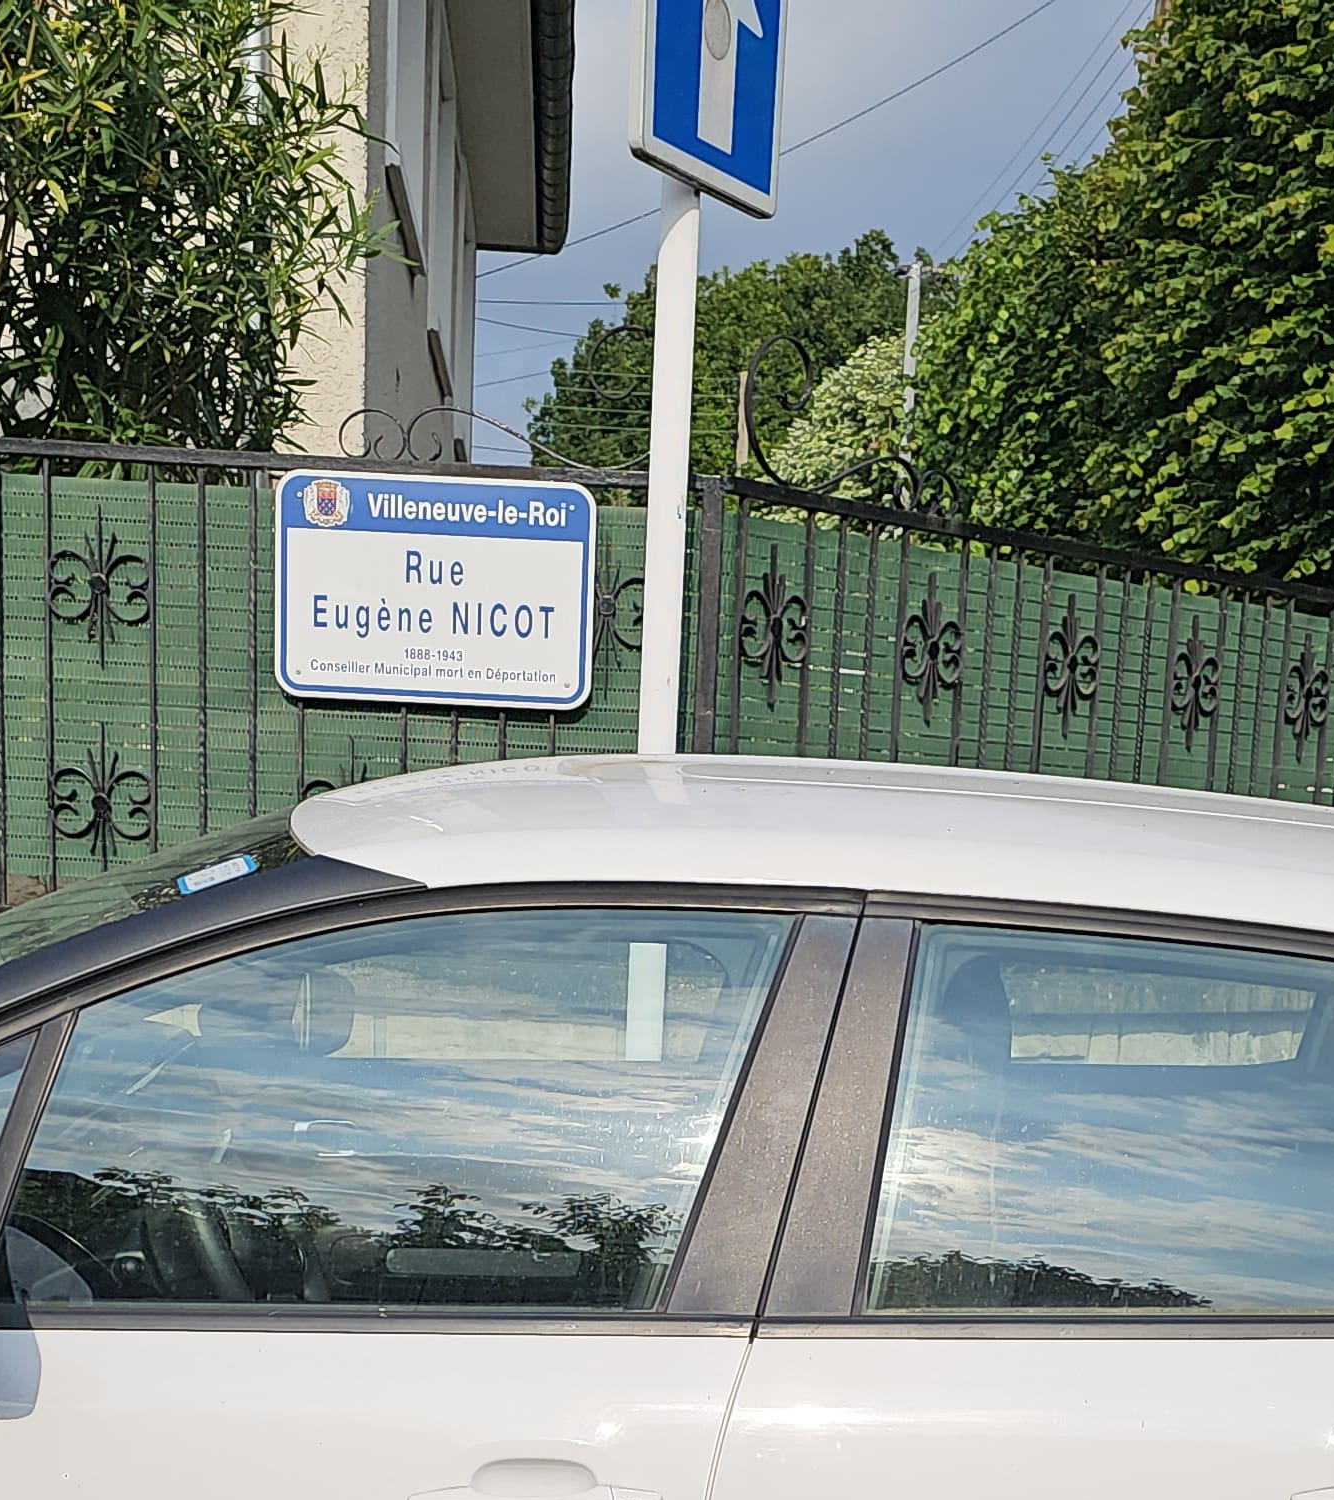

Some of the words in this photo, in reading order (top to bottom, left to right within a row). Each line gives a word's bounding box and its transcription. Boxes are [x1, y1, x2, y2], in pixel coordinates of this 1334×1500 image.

[367, 493, 567, 527] Villeneuve-le-Roi
[405, 550, 465, 586] Rue
[313, 594, 433, 638] Eugène
[452, 601, 555, 639] NICOT
[310, 659, 370, 674] Conseiller
[374, 663, 432, 679] Municipal
[435, 667, 465, 678] mort
[468, 670, 482, 679] en
[486, 668, 556, 683] Déportation
[404, 648, 463, 662] 1888-1943
